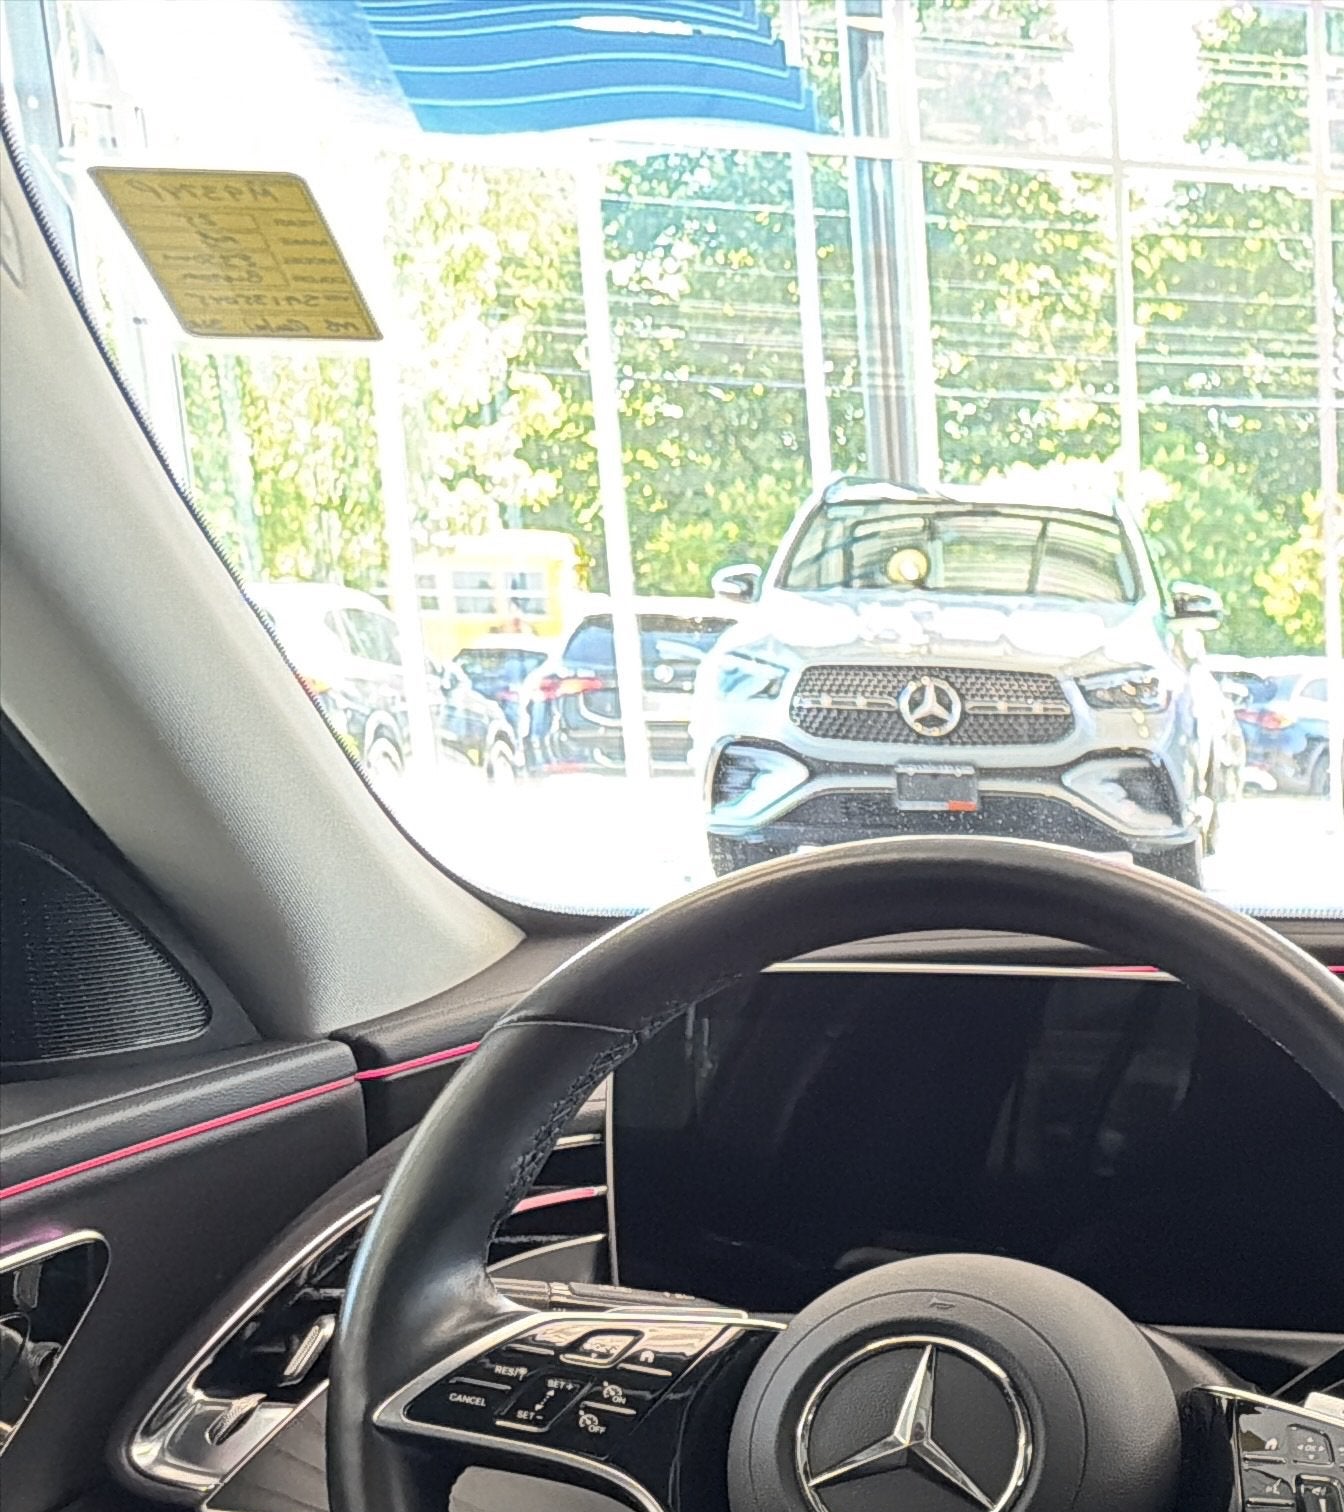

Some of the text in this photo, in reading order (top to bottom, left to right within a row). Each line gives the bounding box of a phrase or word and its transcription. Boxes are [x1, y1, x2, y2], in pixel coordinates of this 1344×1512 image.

[449, 1392, 486, 1407] CANCEL
[612, 1396, 627, 1405] ON
[587, 1424, 607, 1434] OFF
